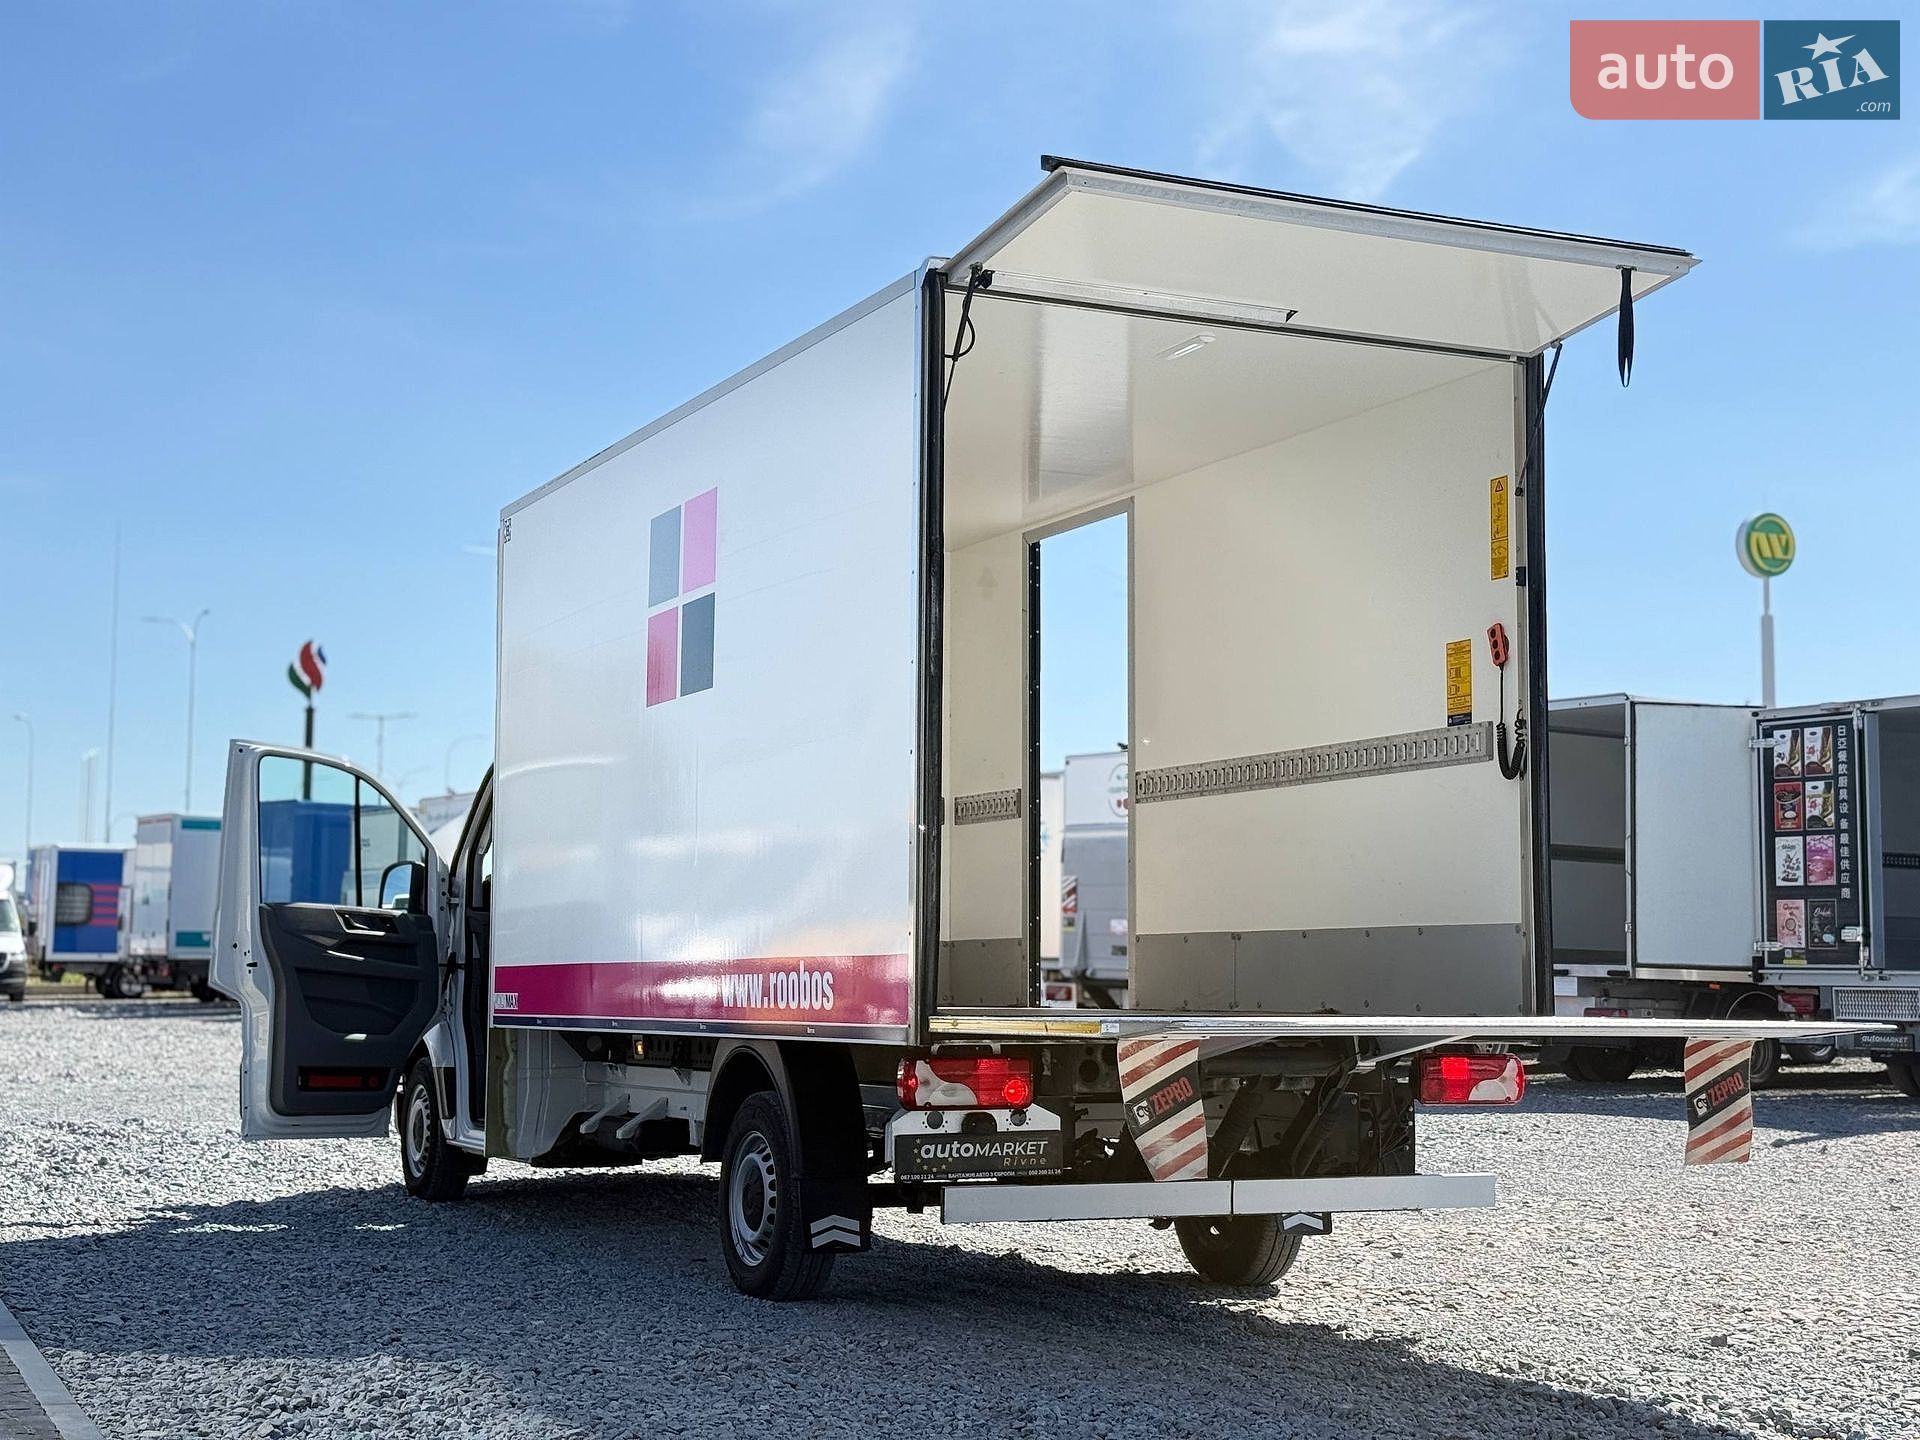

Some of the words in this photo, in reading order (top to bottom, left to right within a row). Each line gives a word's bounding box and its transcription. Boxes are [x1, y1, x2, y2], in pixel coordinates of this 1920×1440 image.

[721, 960, 834, 1011] www.roobos
[1151, 1077, 1194, 1115] ZEPRO
[1707, 1071, 1745, 1107] ZEPRO
[920, 1140, 1049, 1159] autoMARKET
[1003, 1157, 1048, 1167] Rivne
